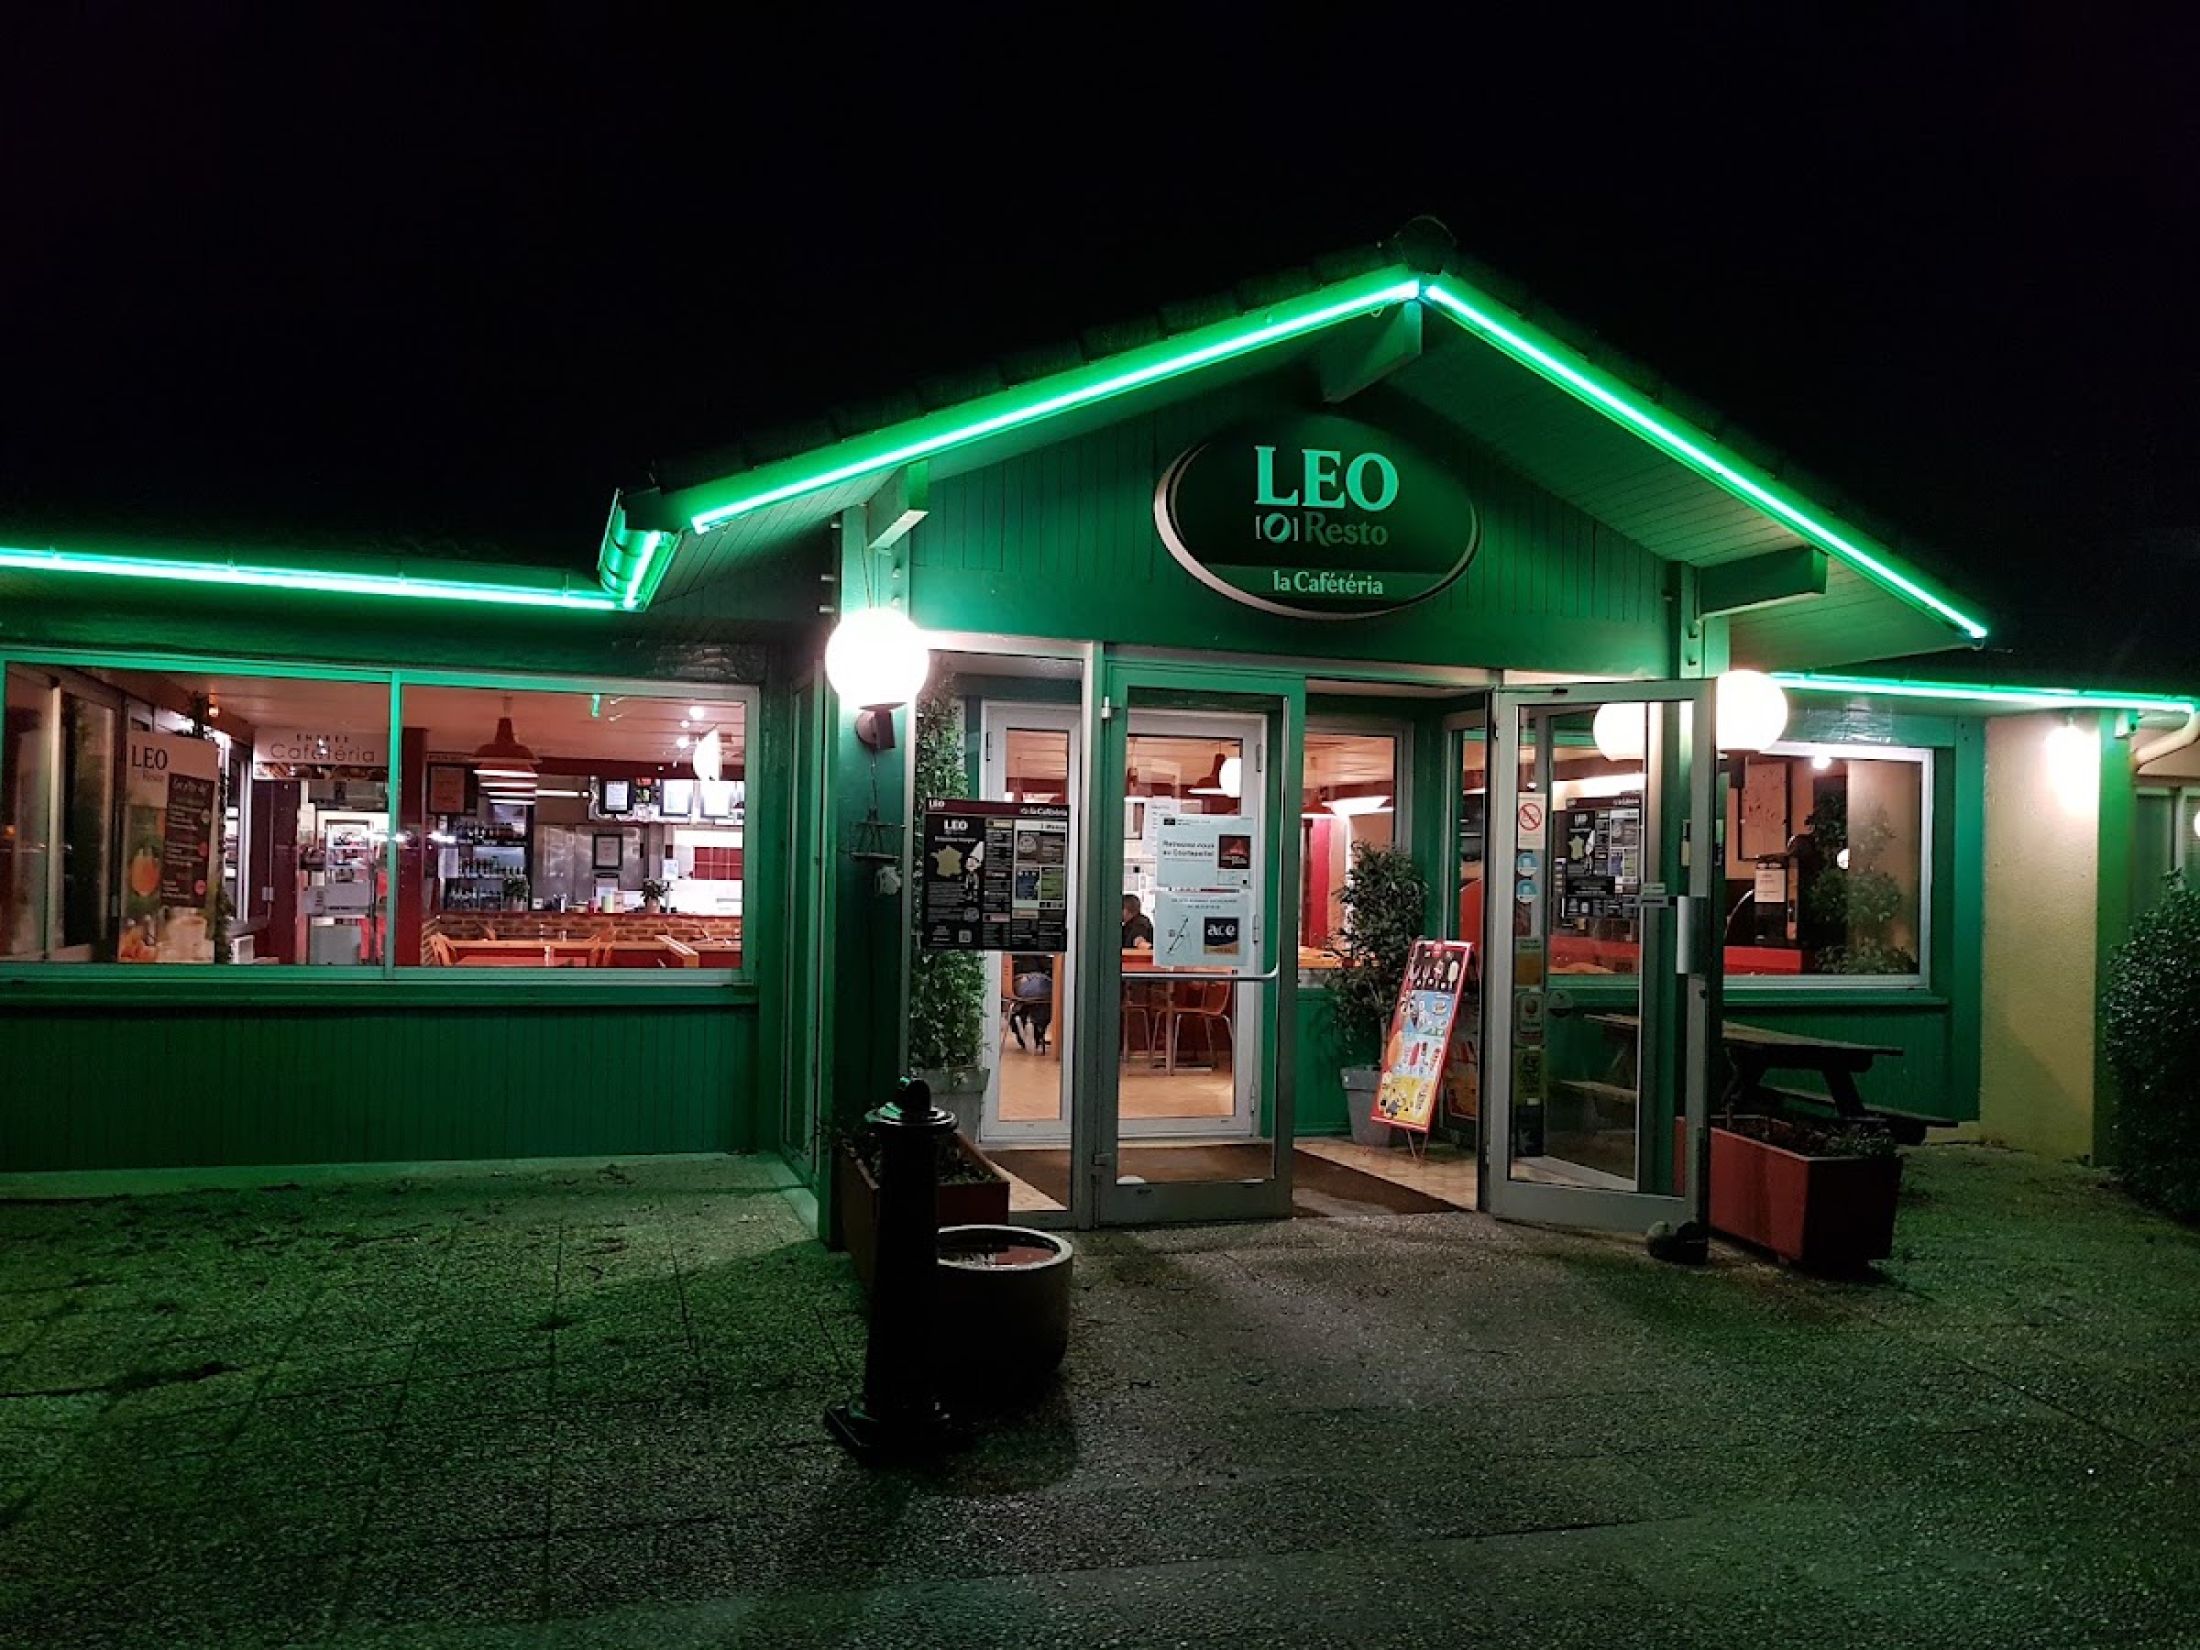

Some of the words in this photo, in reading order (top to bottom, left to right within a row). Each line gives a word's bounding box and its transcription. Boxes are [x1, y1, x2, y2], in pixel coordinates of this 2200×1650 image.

[1254, 445, 1399, 512] LEO
[1303, 511, 1389, 546] Resto
[1272, 569, 1292, 591] la
[1293, 571, 1384, 595] Cafétéria
[131, 744, 168, 770] LEO
